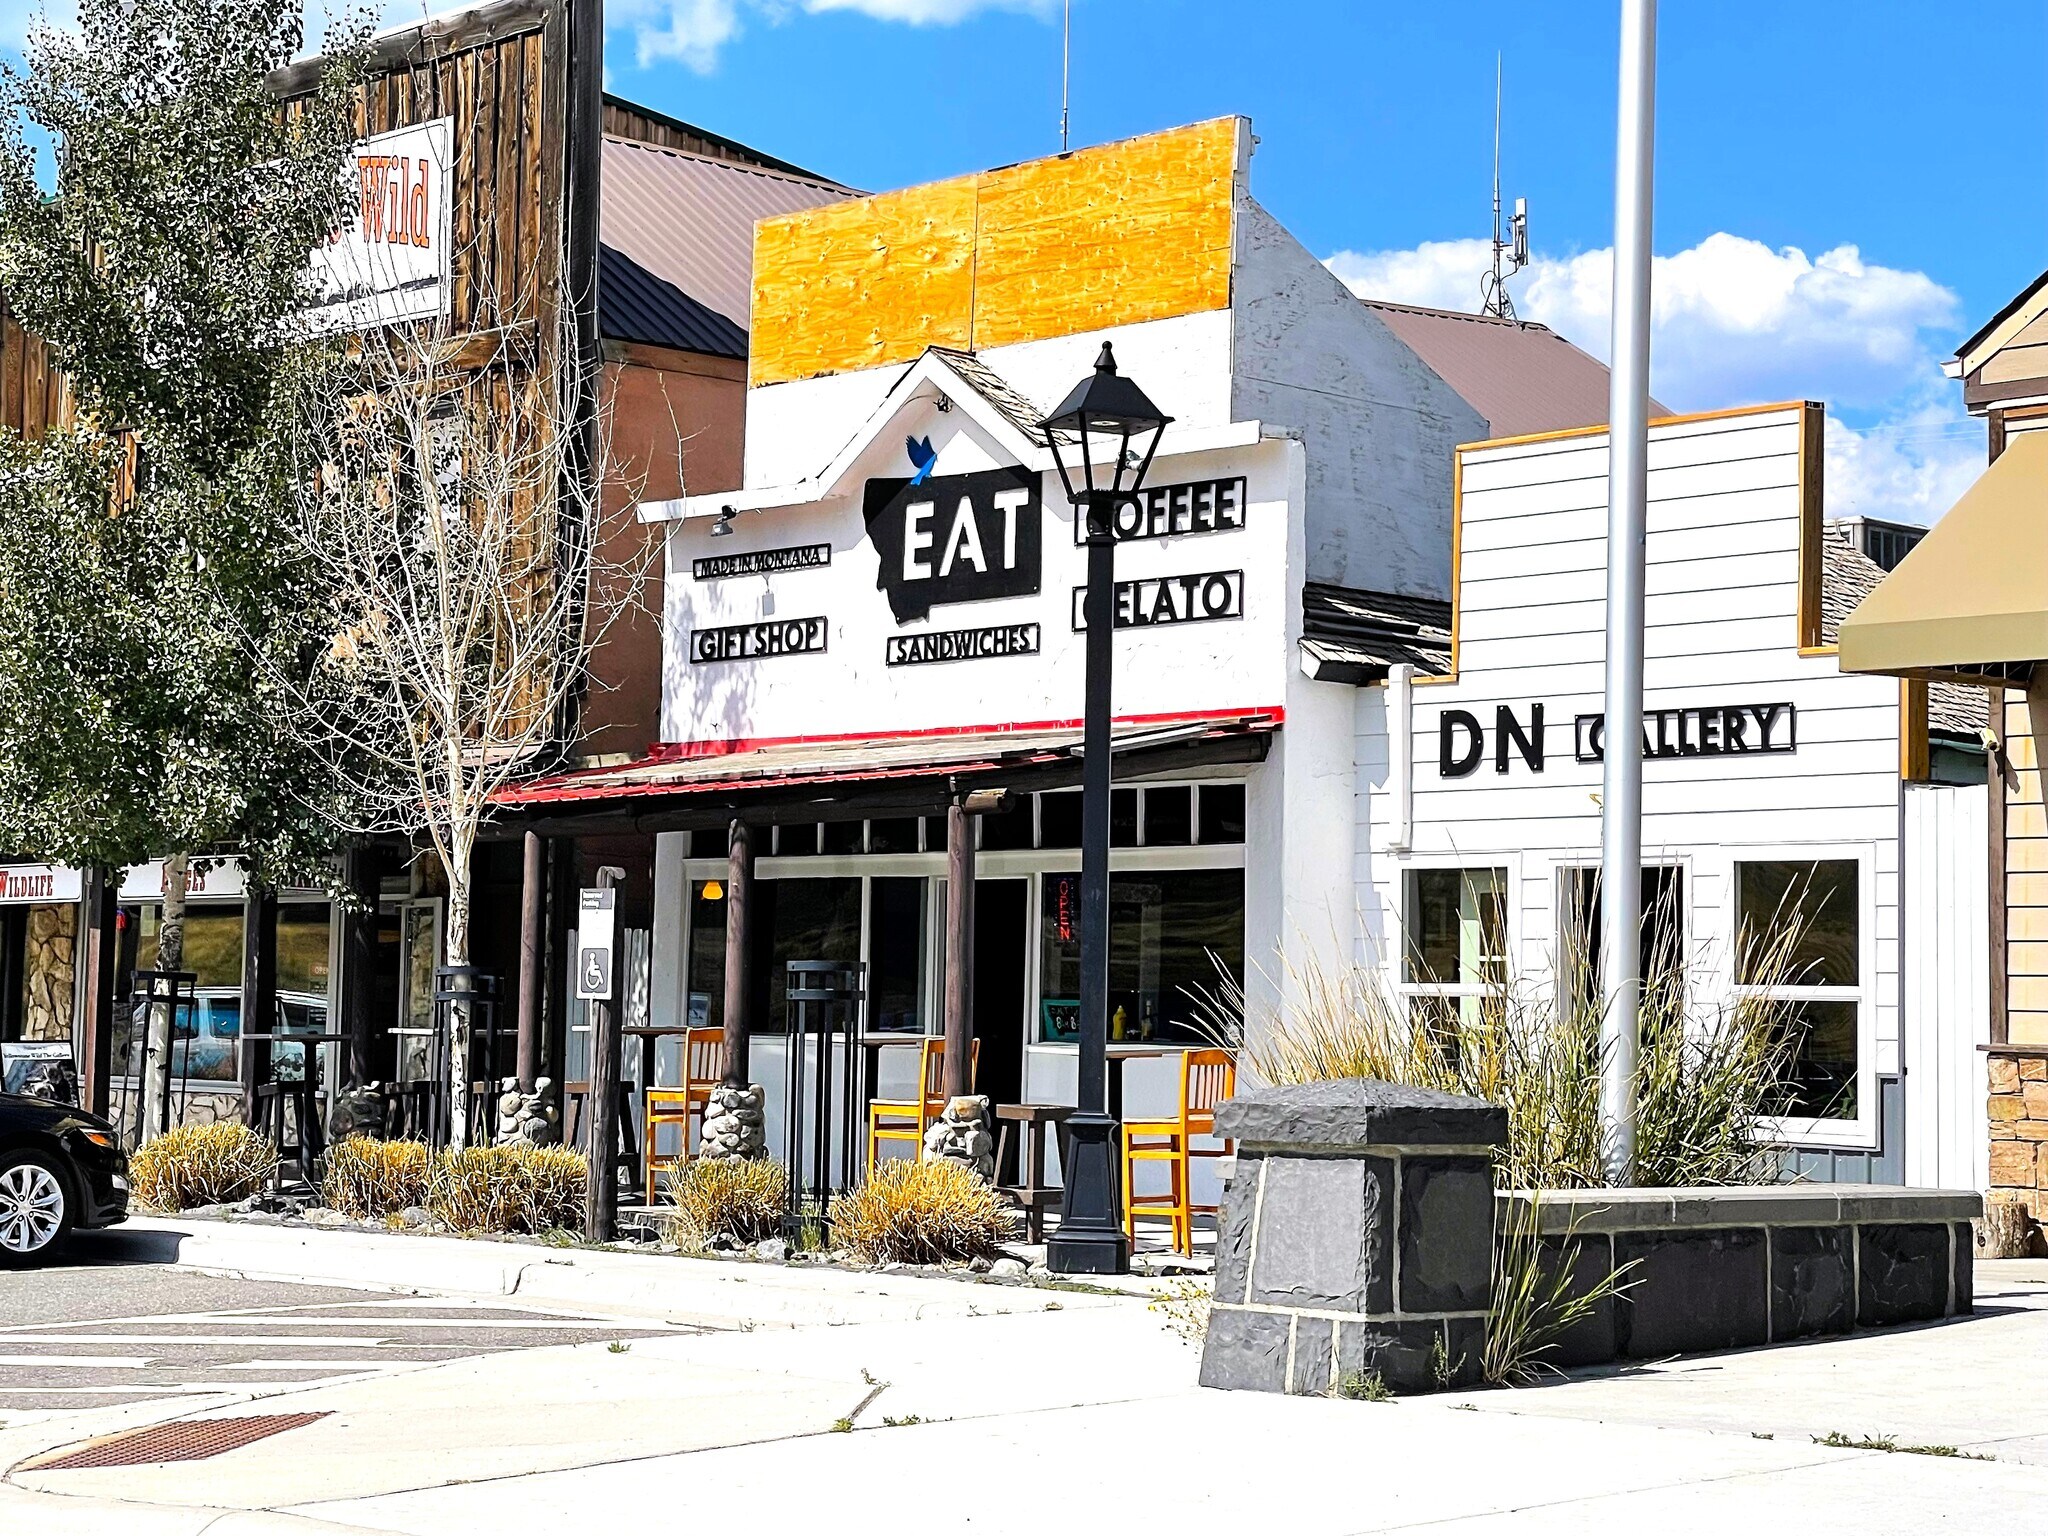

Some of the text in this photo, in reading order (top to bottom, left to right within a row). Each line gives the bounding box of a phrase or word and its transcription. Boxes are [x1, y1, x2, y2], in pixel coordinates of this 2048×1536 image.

[358, 155, 430, 249] Wild
[903, 487, 1029, 581] EAT
[1087, 478, 1236, 538] OFFEE
[702, 547, 820, 576] MADE IN MONTANA
[1083, 573, 1232, 629] ELATO
[699, 619, 818, 660] GIFT SHOP
[897, 626, 1030, 660] SANDWICHES
[1440, 703, 1778, 776] DN LLERY
[1059, 881, 1070, 940] OPEN
